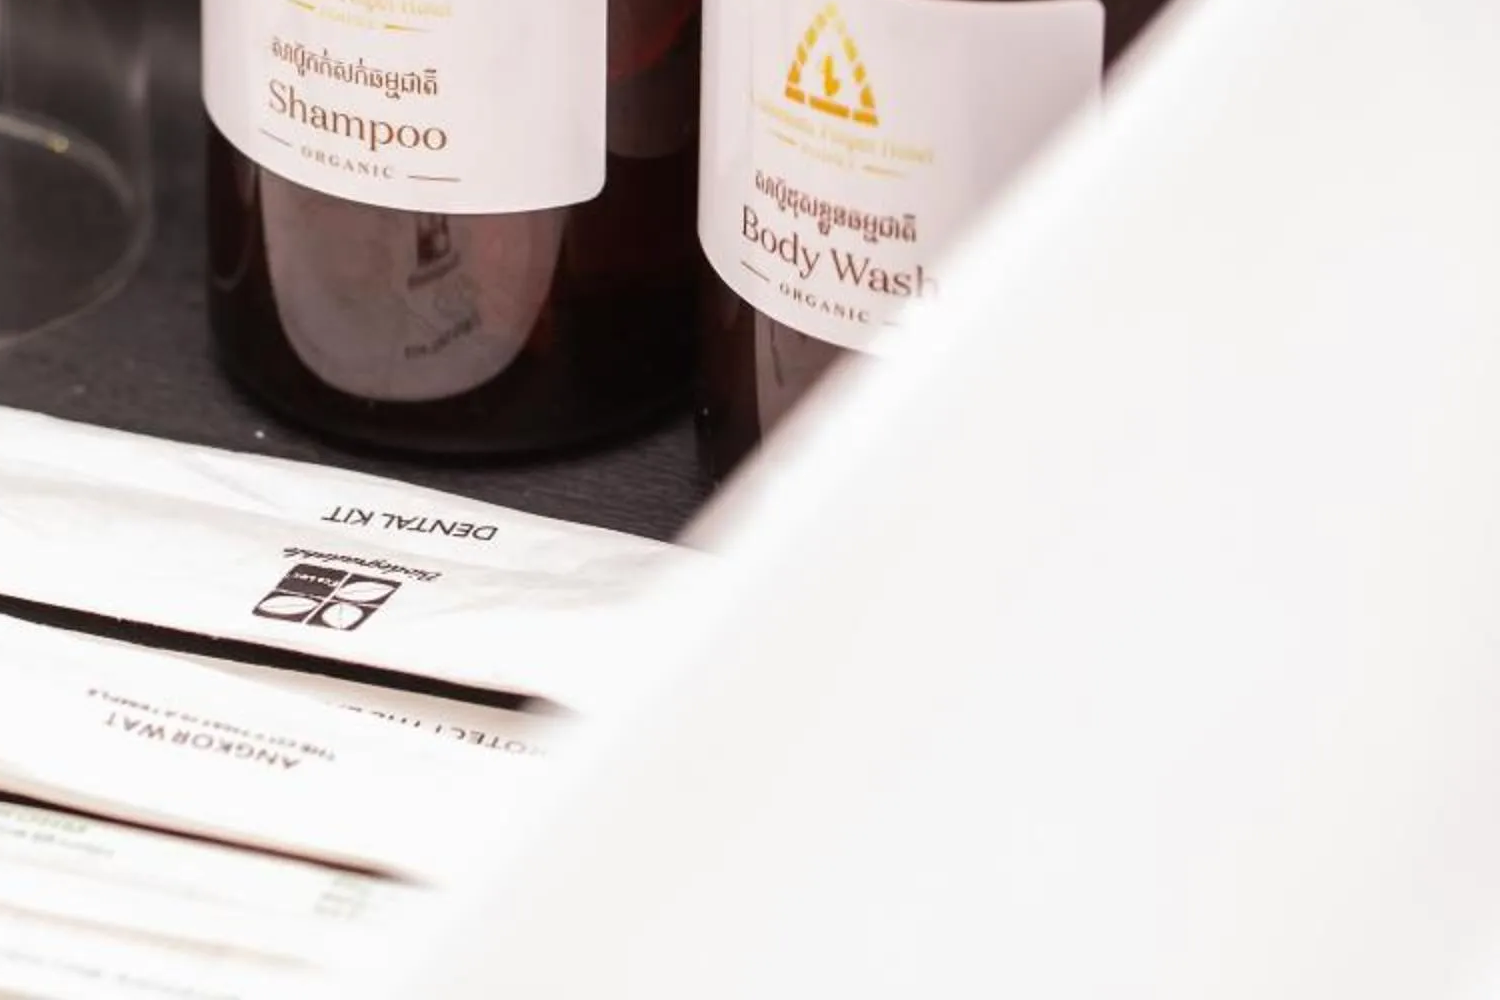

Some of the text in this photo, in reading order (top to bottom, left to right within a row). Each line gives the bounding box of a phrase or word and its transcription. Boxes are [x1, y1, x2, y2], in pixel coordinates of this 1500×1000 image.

[268, 78, 447, 153] Shampoo
[300, 146, 395, 180] ORGANIC
[740, 205, 821, 279] Body
[779, 282, 871, 323] ORGANIC
[320, 506, 499, 541] DENTAL KIT
[105, 712, 301, 770] ANGKOR WAT
